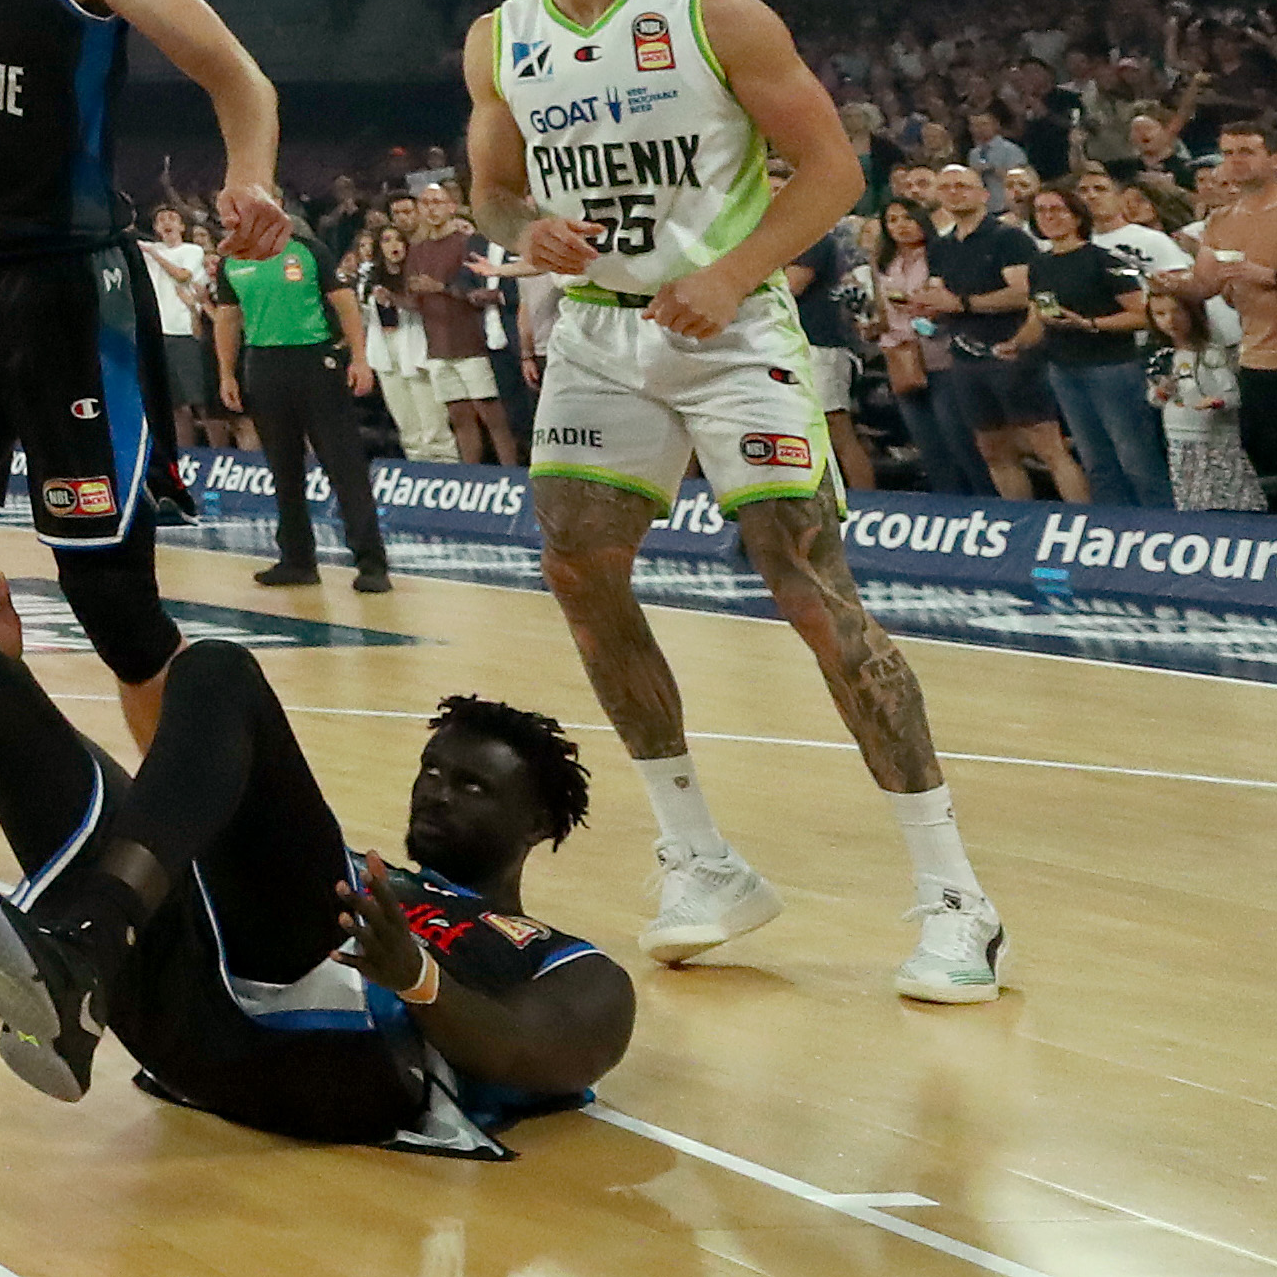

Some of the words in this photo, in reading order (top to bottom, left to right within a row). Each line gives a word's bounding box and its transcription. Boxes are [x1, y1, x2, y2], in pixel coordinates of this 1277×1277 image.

[530, 96, 599, 134] GOAT
[532, 134, 702, 200] PHOENIX
[580, 194, 656, 256] 55
[205, 454, 332, 502] Harcts
[373, 465, 527, 516] Harcourts
[840, 508, 1015, 558] rcourts
[1035, 512, 1277, 581] Harcour
